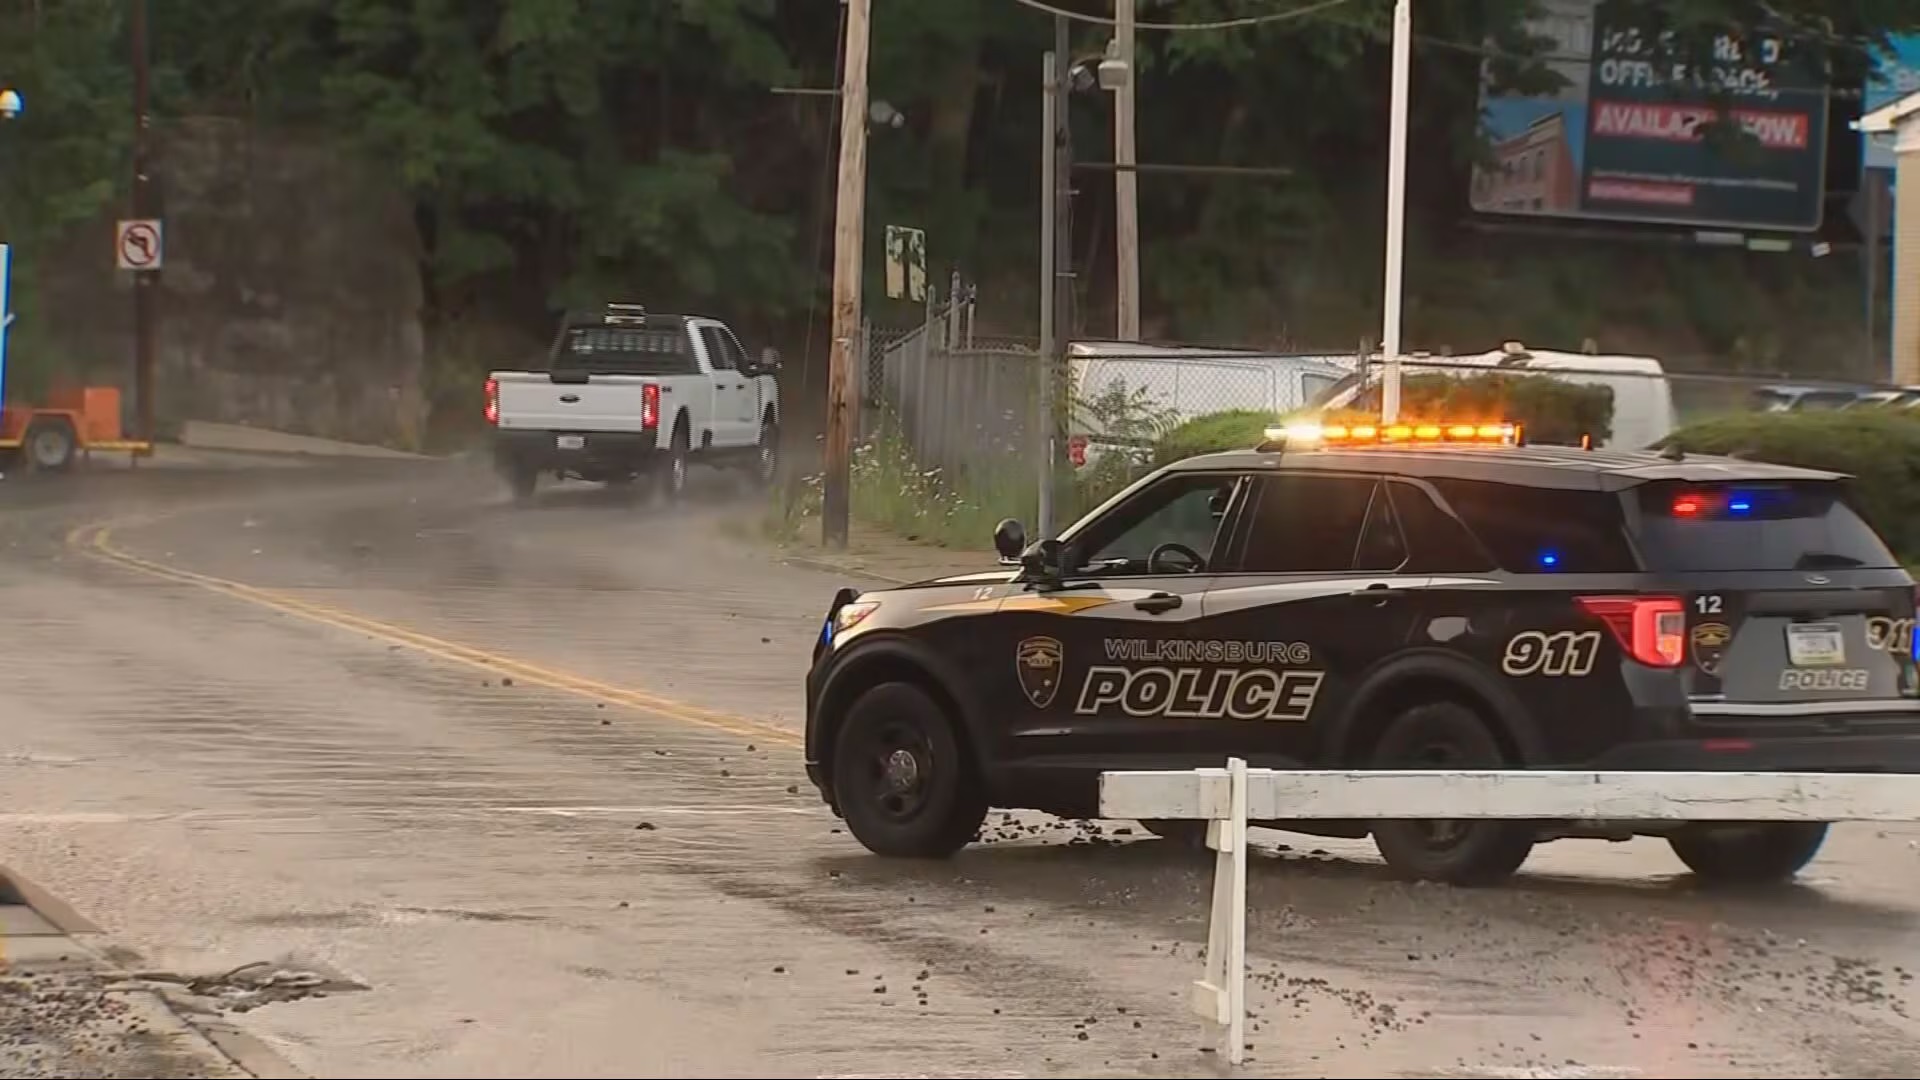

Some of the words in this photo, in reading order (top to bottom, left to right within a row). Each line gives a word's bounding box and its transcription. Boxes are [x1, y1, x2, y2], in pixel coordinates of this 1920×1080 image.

[974, 587, 993, 600] 12
[1696, 596, 1722, 613] 12
[1865, 616, 1914, 654] 911
[1104, 639, 1311, 664] WILKINSBURG
[1503, 631, 1601, 676] 911
[1779, 668, 1868, 691] POLICE
[1075, 667, 1325, 721] POLICE
